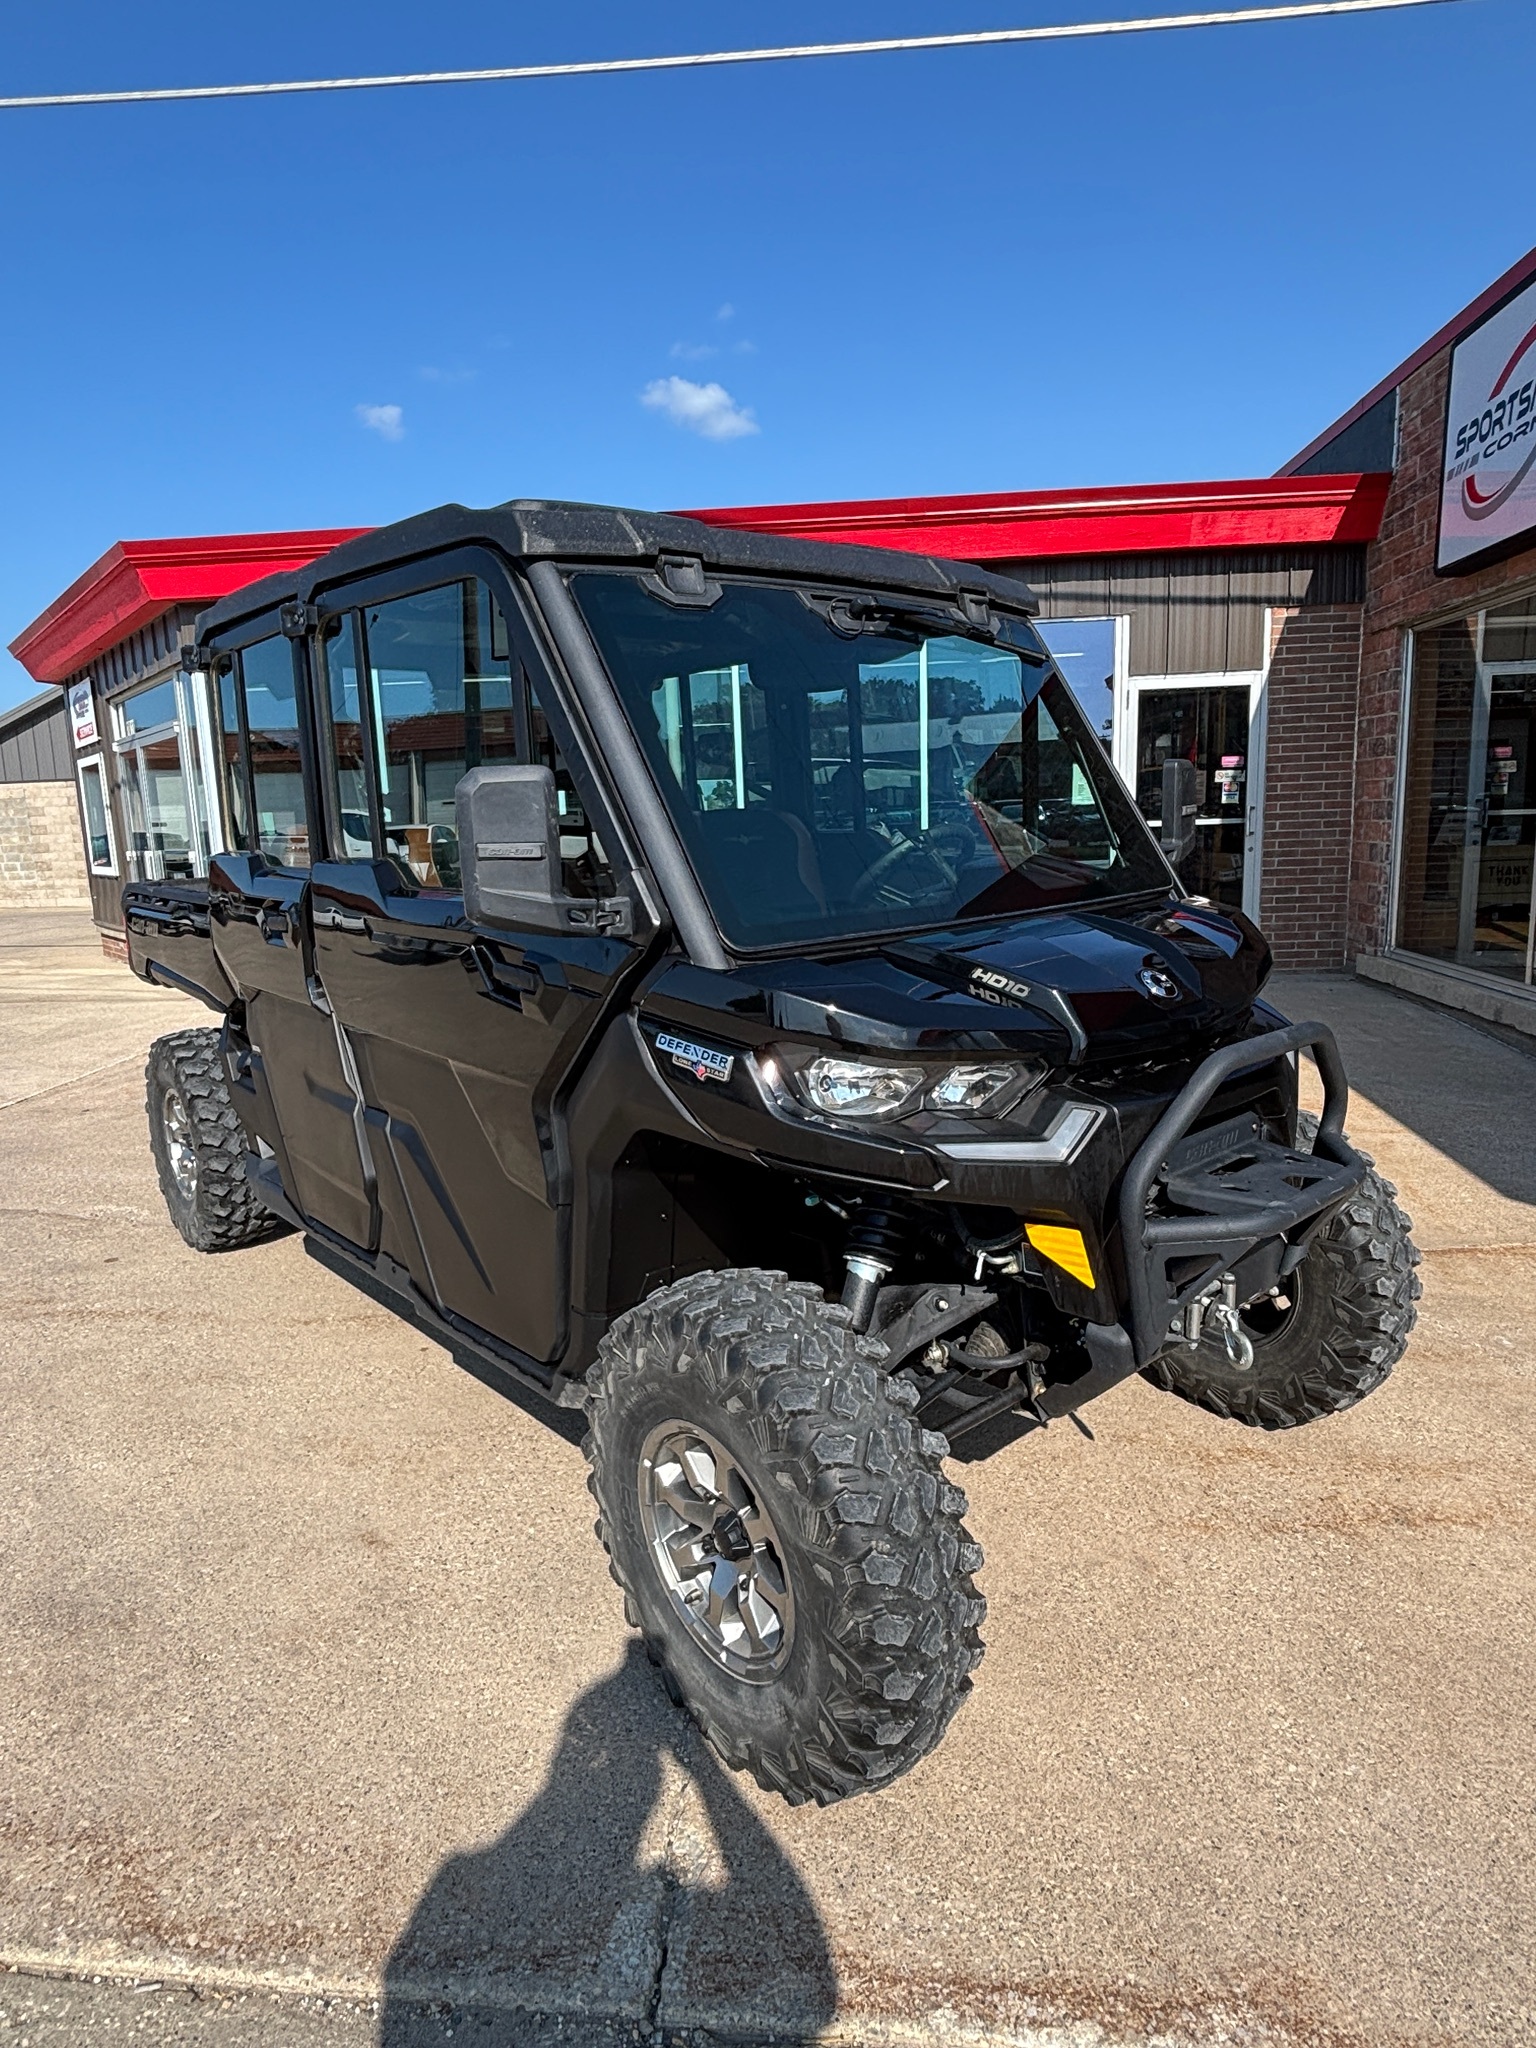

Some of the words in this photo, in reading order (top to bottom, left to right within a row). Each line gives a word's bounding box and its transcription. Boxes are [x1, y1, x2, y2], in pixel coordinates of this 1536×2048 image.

[1454, 379, 1536, 459] SPORTS
[1487, 865, 1529, 877] THANK
[1496, 876, 1521, 887] YOU
[970, 967, 1030, 997] HD10
[658, 1035, 729, 1070] DEFENDER
[674, 1055, 693, 1067] LONE
[706, 1067, 725, 1078] STAR
